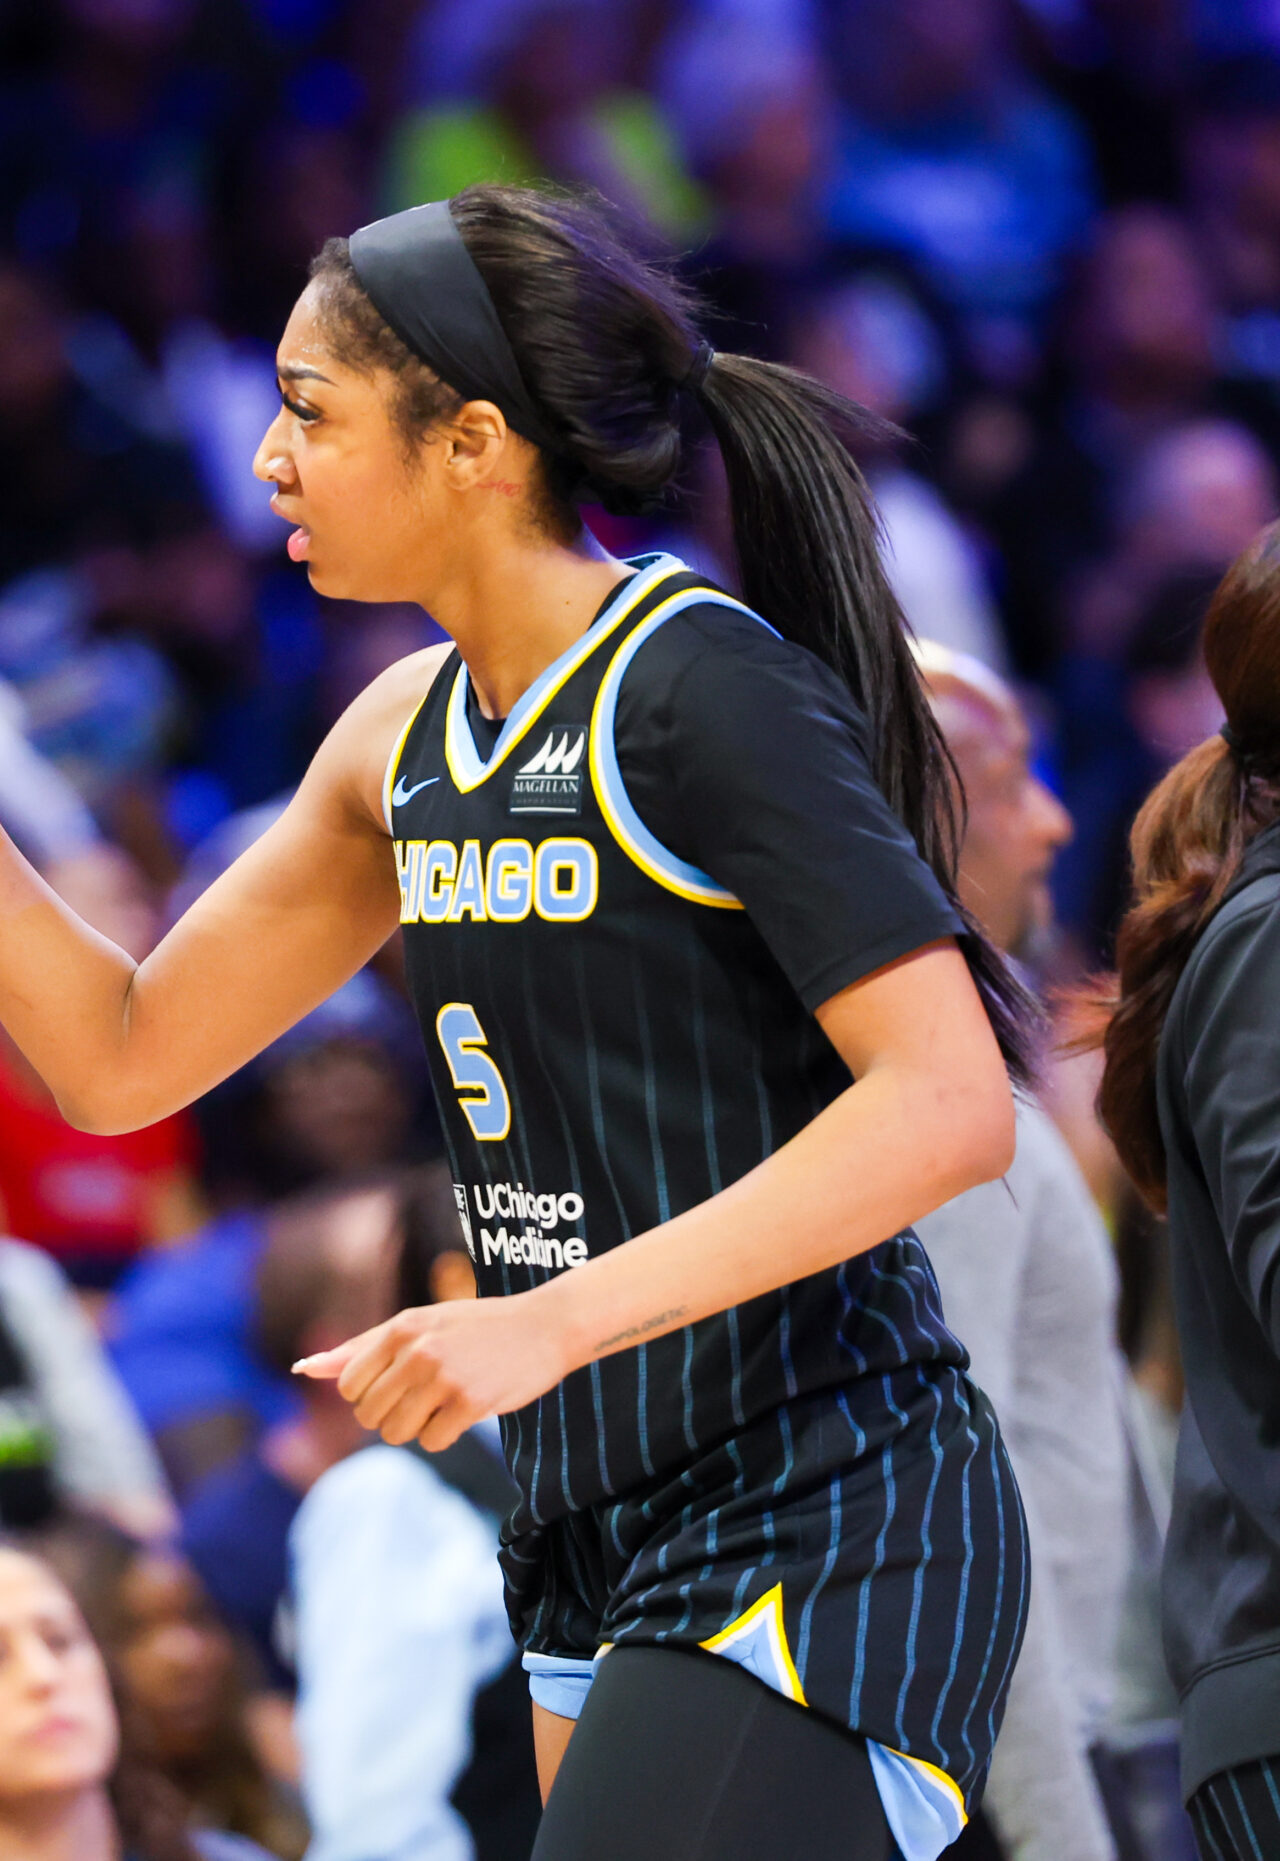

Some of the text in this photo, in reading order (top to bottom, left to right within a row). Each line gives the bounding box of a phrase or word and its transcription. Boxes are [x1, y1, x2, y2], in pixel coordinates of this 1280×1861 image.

[513, 780, 579, 793] MAGELLAN
[393, 837, 599, 924] HICAGO
[436, 1002, 511, 1141] 5
